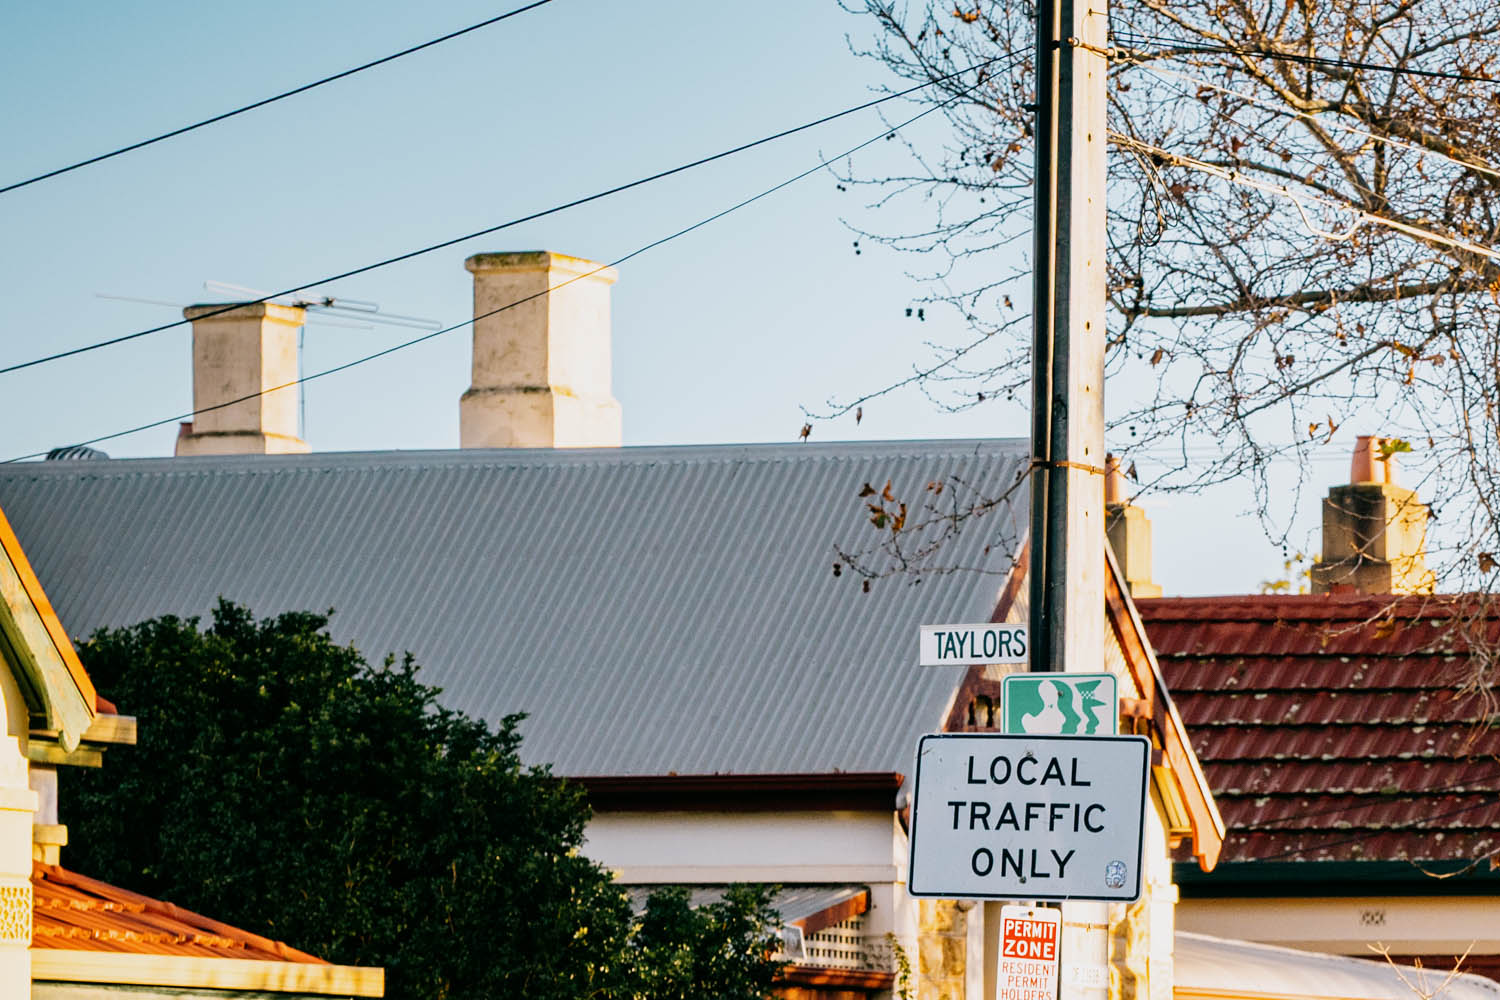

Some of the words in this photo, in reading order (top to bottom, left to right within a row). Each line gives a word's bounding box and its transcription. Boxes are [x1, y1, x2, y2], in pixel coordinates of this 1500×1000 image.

[933, 629, 1026, 660] TAYLORS
[967, 755, 1092, 787] LOCAL
[947, 801, 1107, 833] TRAFFIC
[971, 847, 1076, 879] ONLY
[1005, 919, 1056, 940] PERMIT
[1003, 939, 1054, 959] ZONE
[1002, 961, 1056, 977] RESIDENT
[1007, 975, 1049, 990] PERMIT
